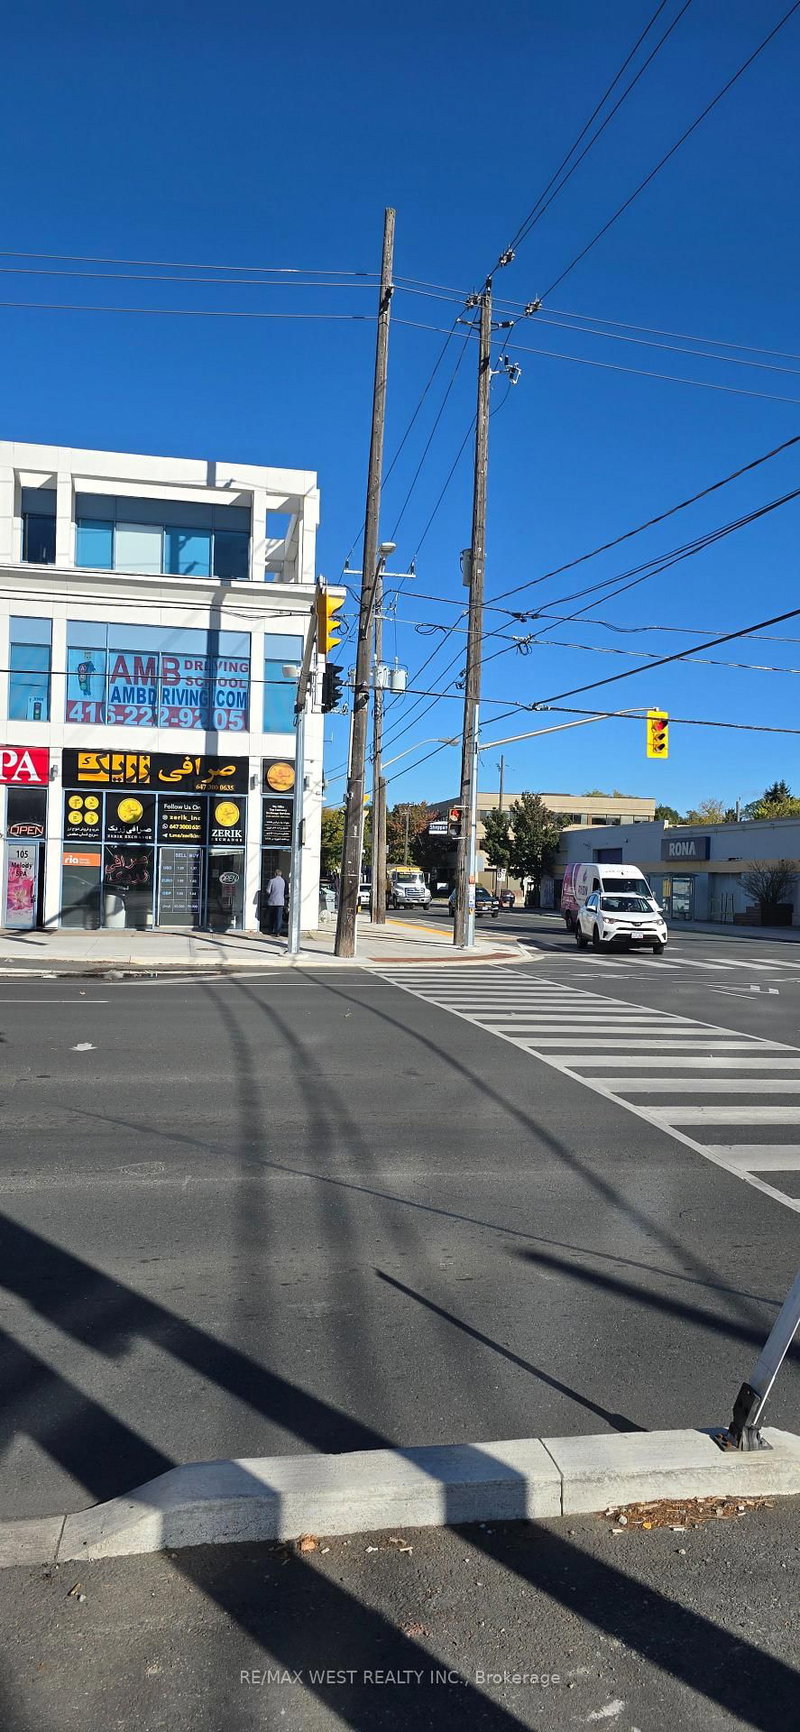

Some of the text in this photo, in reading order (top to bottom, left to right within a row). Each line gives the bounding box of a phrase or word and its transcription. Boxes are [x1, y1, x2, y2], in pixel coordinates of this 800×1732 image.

[110, 655, 180, 686] AMB
[184, 660, 248, 672] DRIVING
[185, 676, 247, 688] SCHOOL
[111, 686, 246, 708] AMBDRIVING.COM
[69, 702, 243, 730] 416-222-9205
[158, 756, 237, 784] صرافی
[10, 826, 43, 835] OPEN
[211, 829, 242, 838] ZERIK
[16, 850, 29, 858] 105
[669, 842, 695, 856] RONA
[65, 855, 78, 864] ria
[11, 862, 33, 870] Melody
